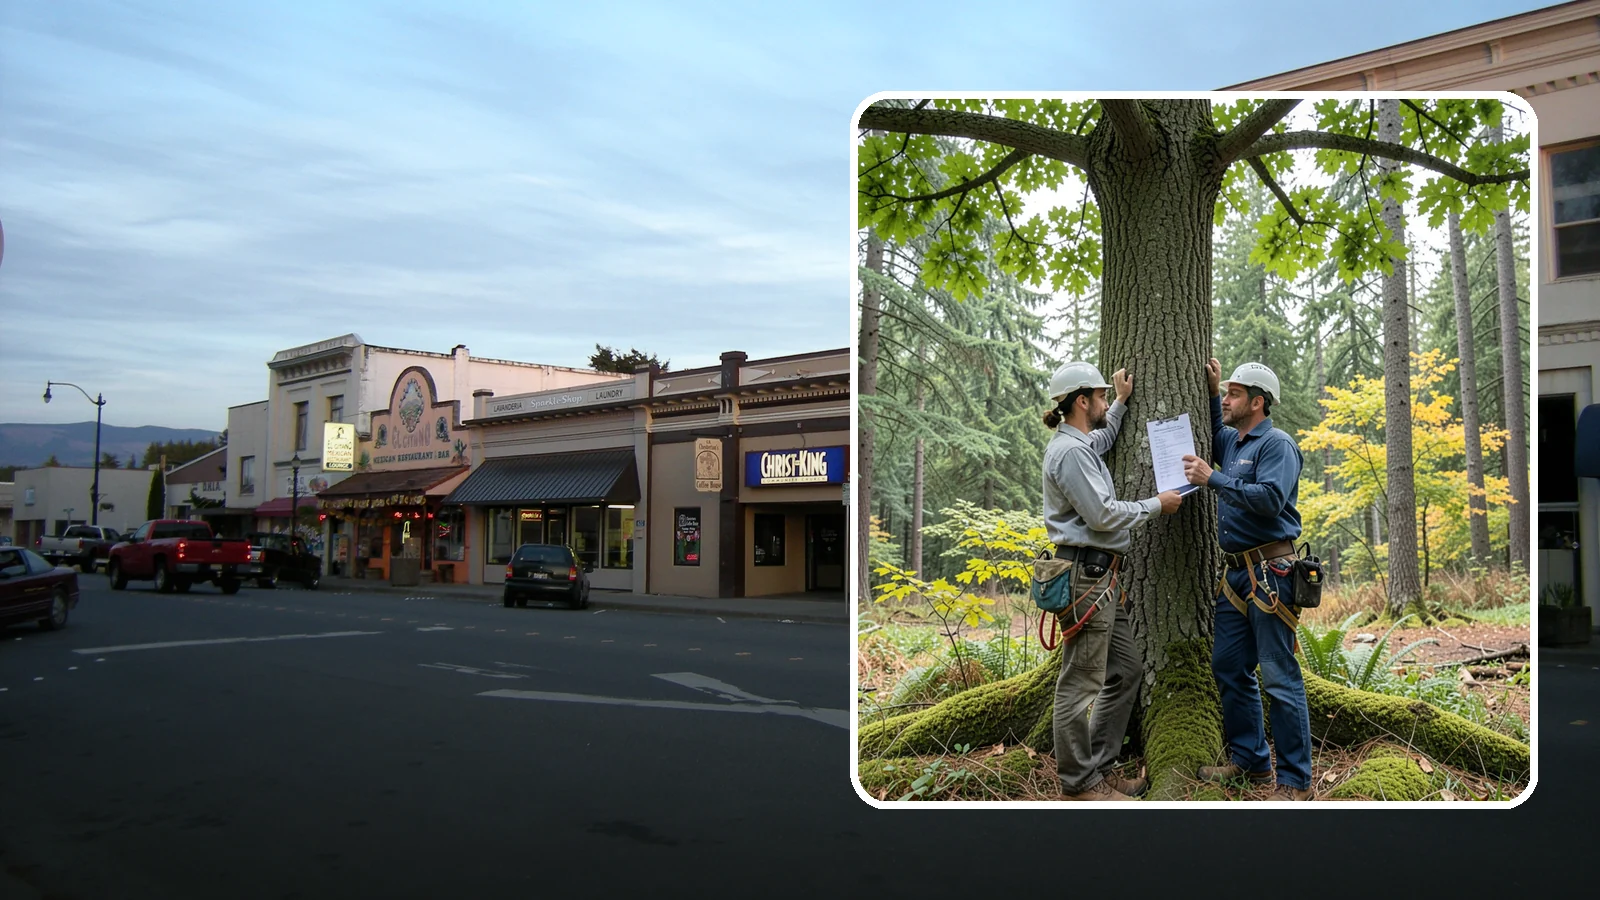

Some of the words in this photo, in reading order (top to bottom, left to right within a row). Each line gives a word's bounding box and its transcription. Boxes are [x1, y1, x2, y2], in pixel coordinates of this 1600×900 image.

[595, 388, 624, 400] LAUNDRY
[494, 402, 523, 412] LAVANDERIA
[530, 398, 561, 410] Sparkle
[562, 394, 583, 405] Shop
[373, 454, 396, 464] MEXICAN
[397, 452, 433, 463] RESTAURANT
[438, 450, 450, 458] BAR
[761, 452, 797, 477] CHRIST
[799, 450, 827, 476] KING
[696, 480, 710, 489] Coffee
[710, 480, 722, 489] House
